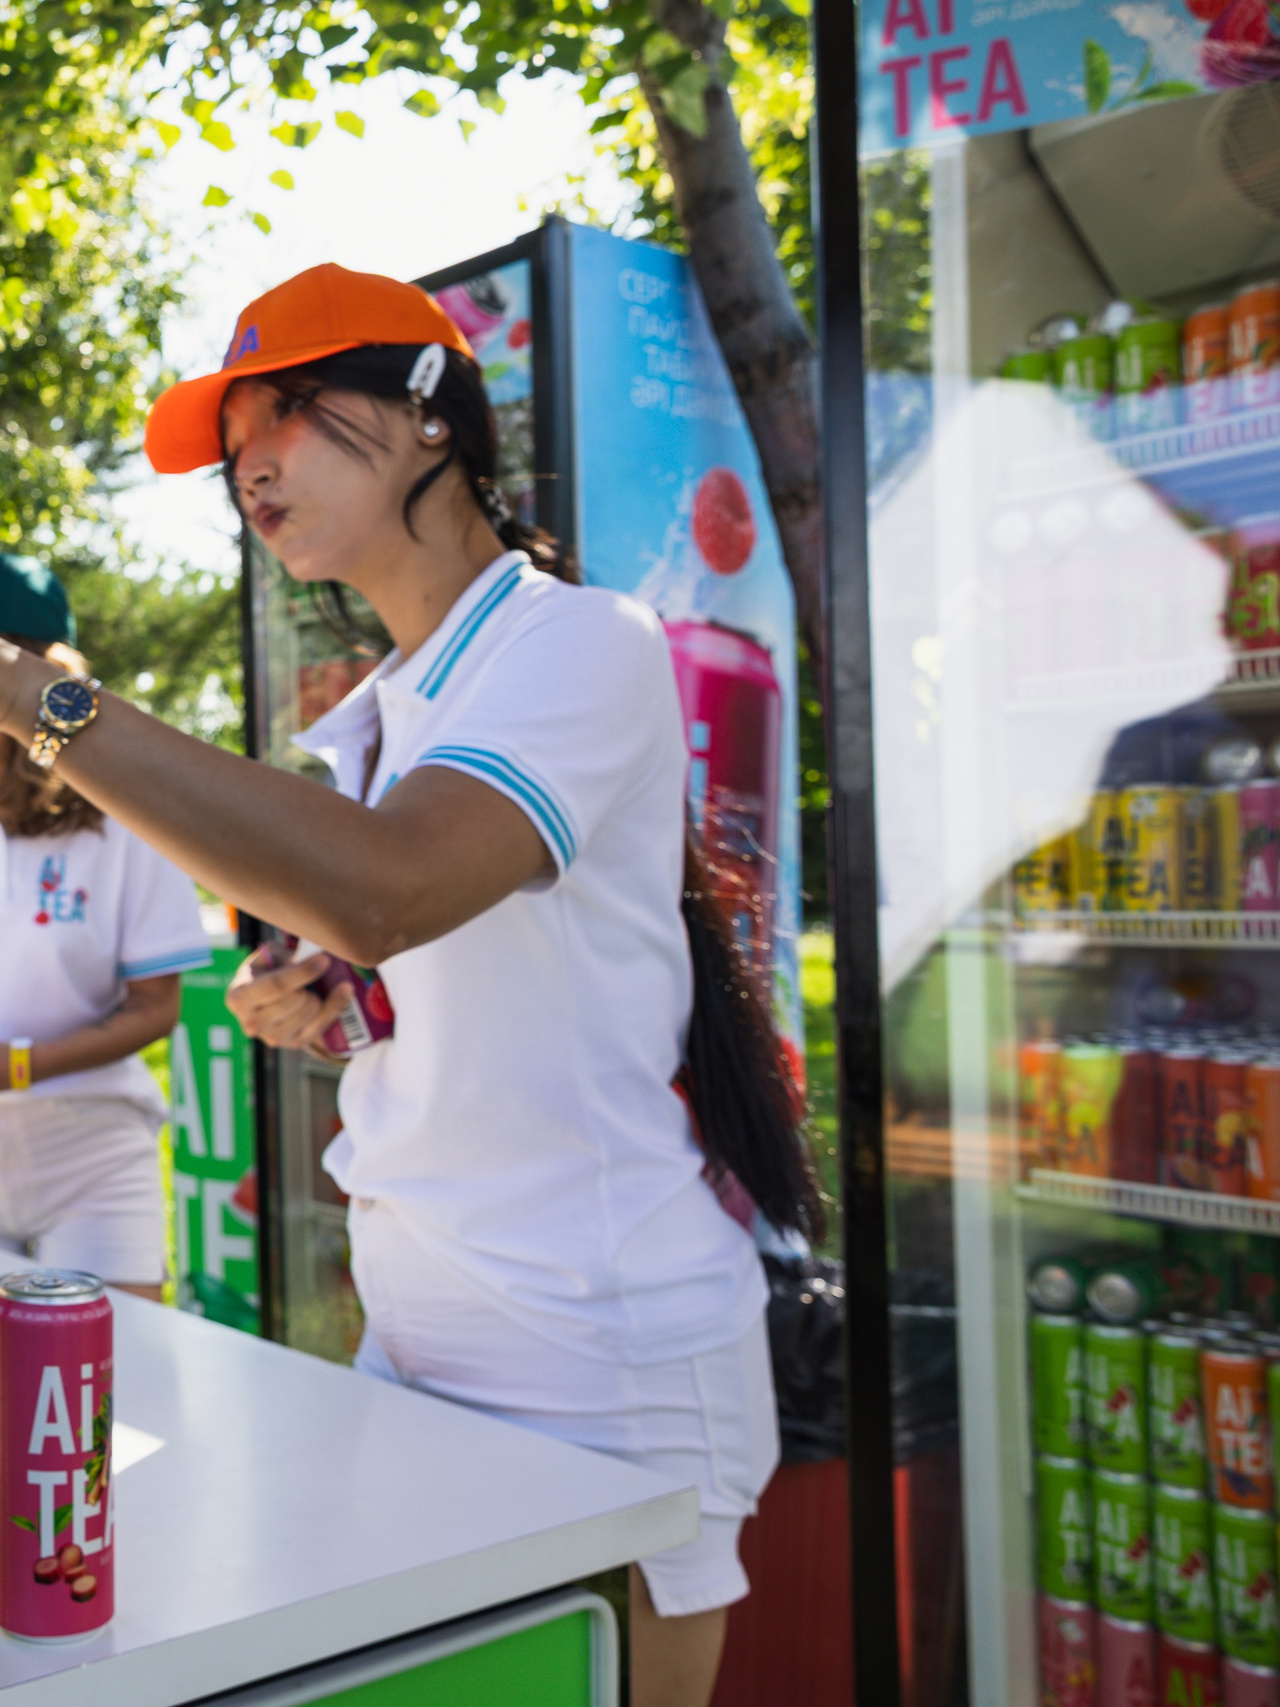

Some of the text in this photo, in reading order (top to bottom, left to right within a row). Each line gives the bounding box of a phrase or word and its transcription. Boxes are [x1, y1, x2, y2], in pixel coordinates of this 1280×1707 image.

[880, 37, 1029, 138] TEA
[38, 888, 87, 924] TEA
[171, 1022, 236, 1160] Ai
[28, 1363, 94, 1456] Ai
[1217, 1383, 1253, 1429] Ai
